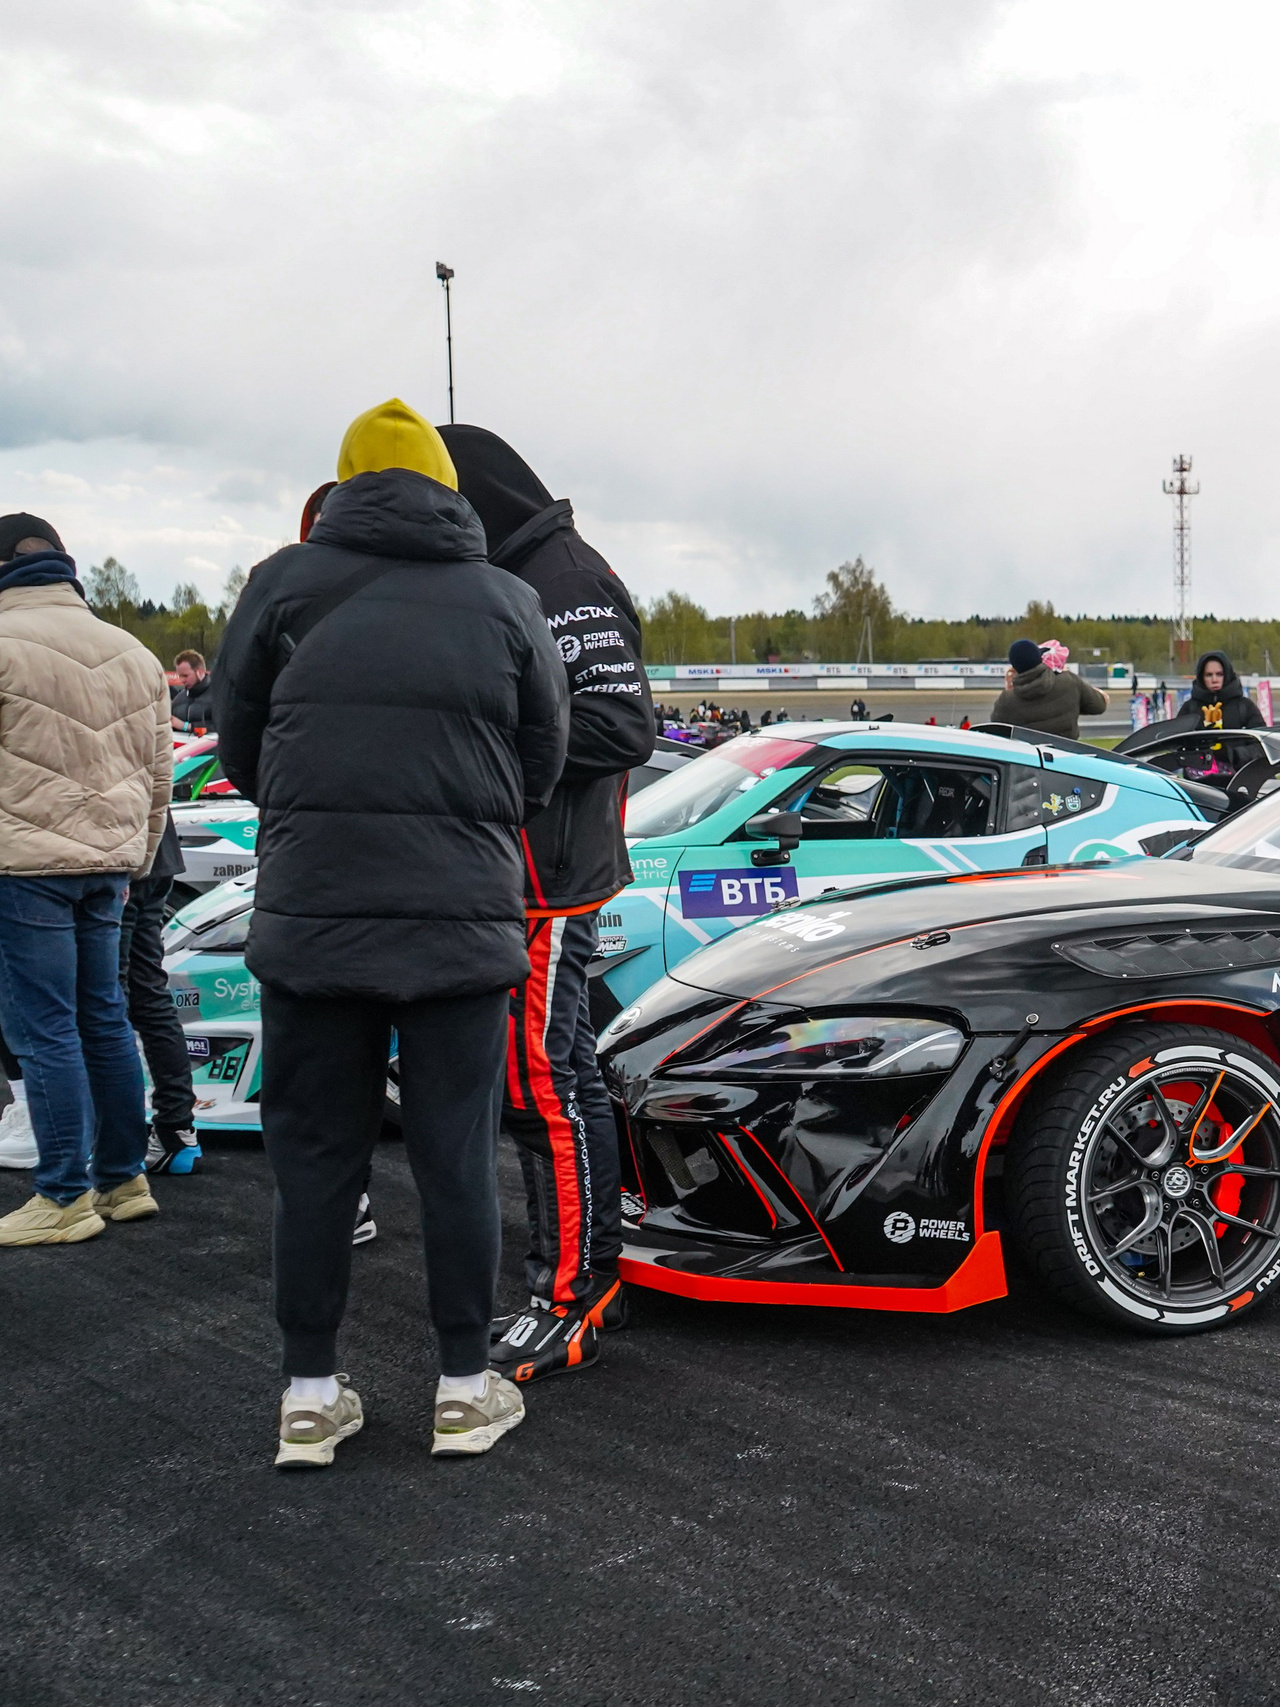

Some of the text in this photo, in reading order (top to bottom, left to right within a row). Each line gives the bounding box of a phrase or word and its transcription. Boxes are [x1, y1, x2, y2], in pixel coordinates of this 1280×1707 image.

[583, 630, 620, 642] POWER
[584, 638, 625, 650] WHEELS
[721, 877, 785, 905] ВТБ
[920, 1218, 965, 1231] POWER
[919, 1228, 970, 1241] WHEELS
